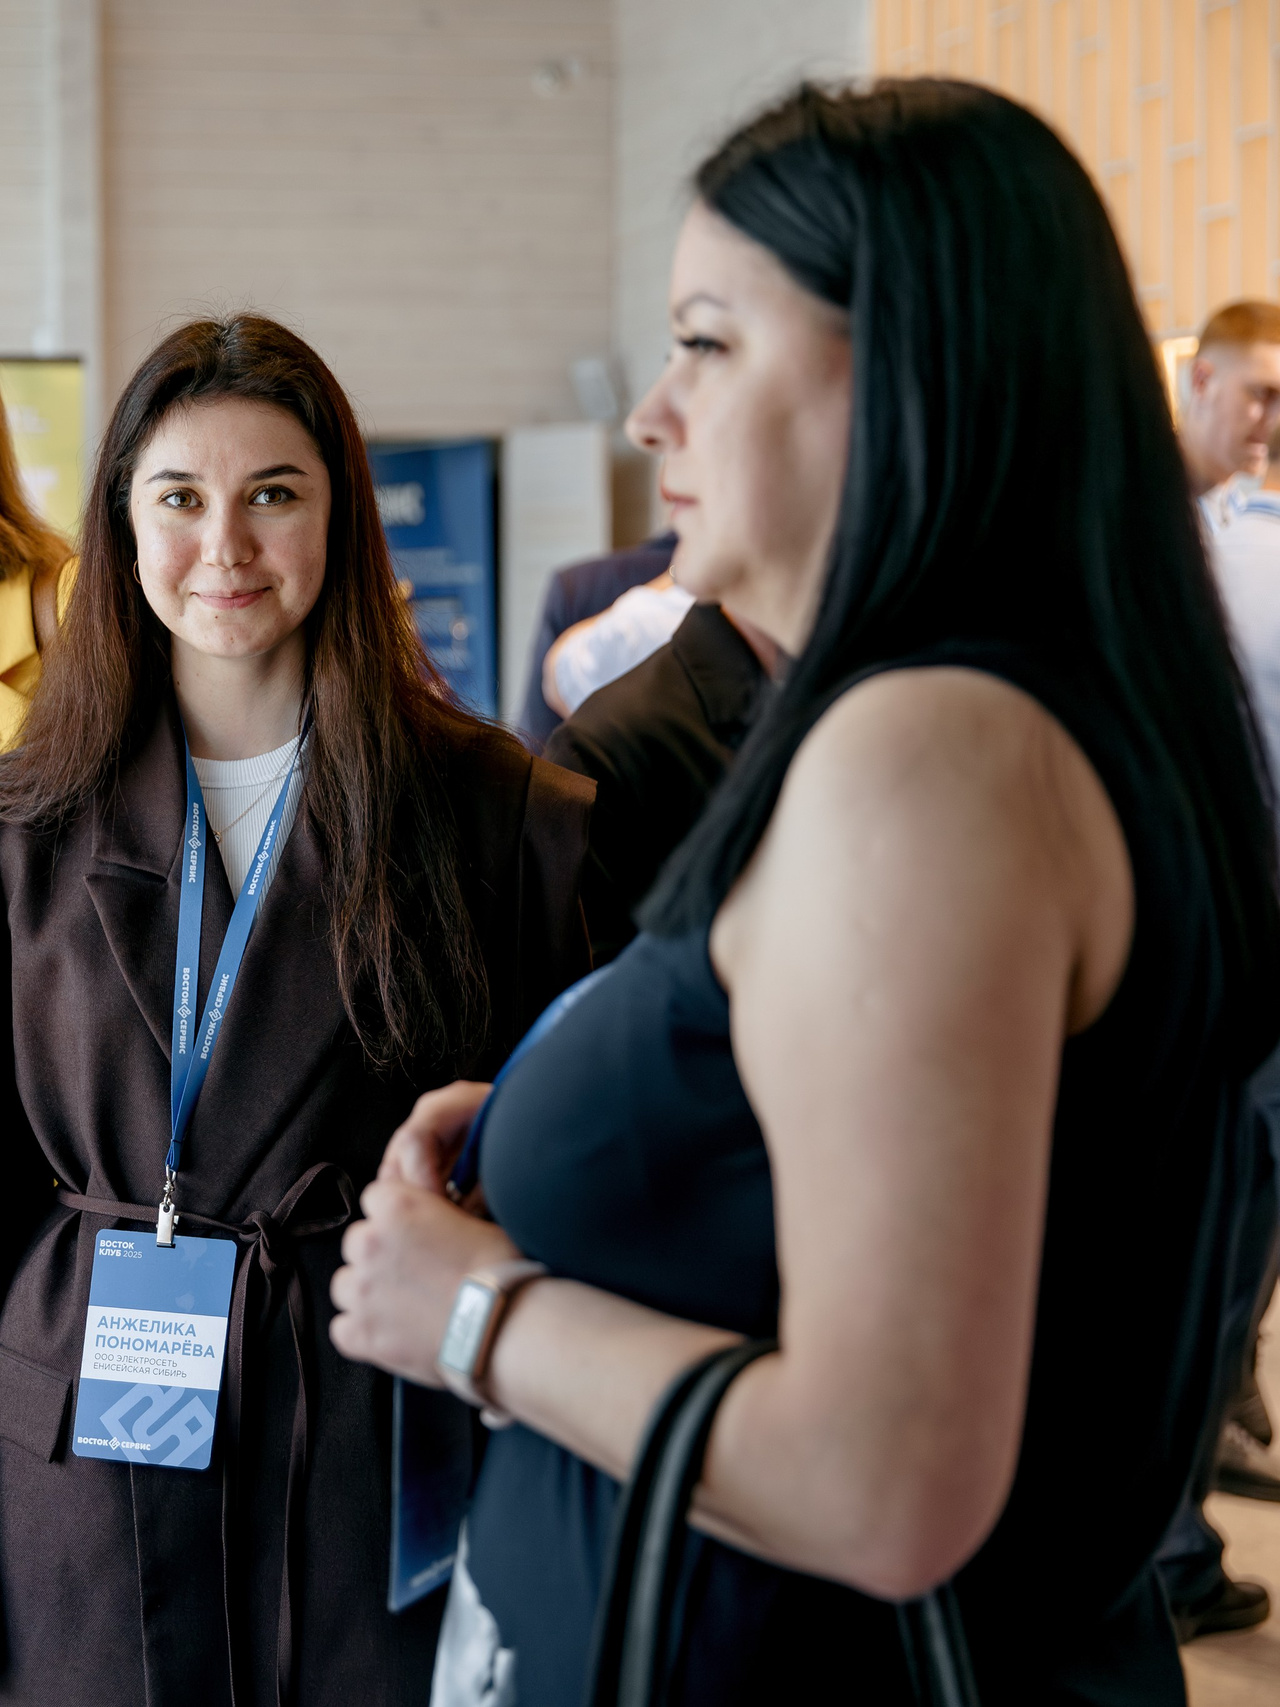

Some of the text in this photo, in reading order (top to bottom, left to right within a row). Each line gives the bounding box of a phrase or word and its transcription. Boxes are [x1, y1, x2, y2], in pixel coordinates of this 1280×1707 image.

[189, 802, 200, 883] ВОСТОК СЕРВИС
[248, 819, 277, 896] ВОСТОК СЕРВИС
[179, 967, 190, 1054] ВОСТОК СЕРВИС
[200, 973, 230, 1060] ВОСТОК СЕРВИС
[98, 1248, 143, 1259] КЛУБ 2025
[99, 1239, 135, 1250] ВОСТОК
[97, 1315, 196, 1337] АНЖЕЛИКА
[95, 1334, 215, 1358] ПОНОМАРЁВА
[93, 1362, 187, 1378] ЕНИСЕЙСКАЯ СИБИРЬ
[94, 1353, 178, 1368] ООО ЭЛЕКТРОСЕТЬ
[77, 1436, 151, 1451] ВОСТОК СЕРВИС
